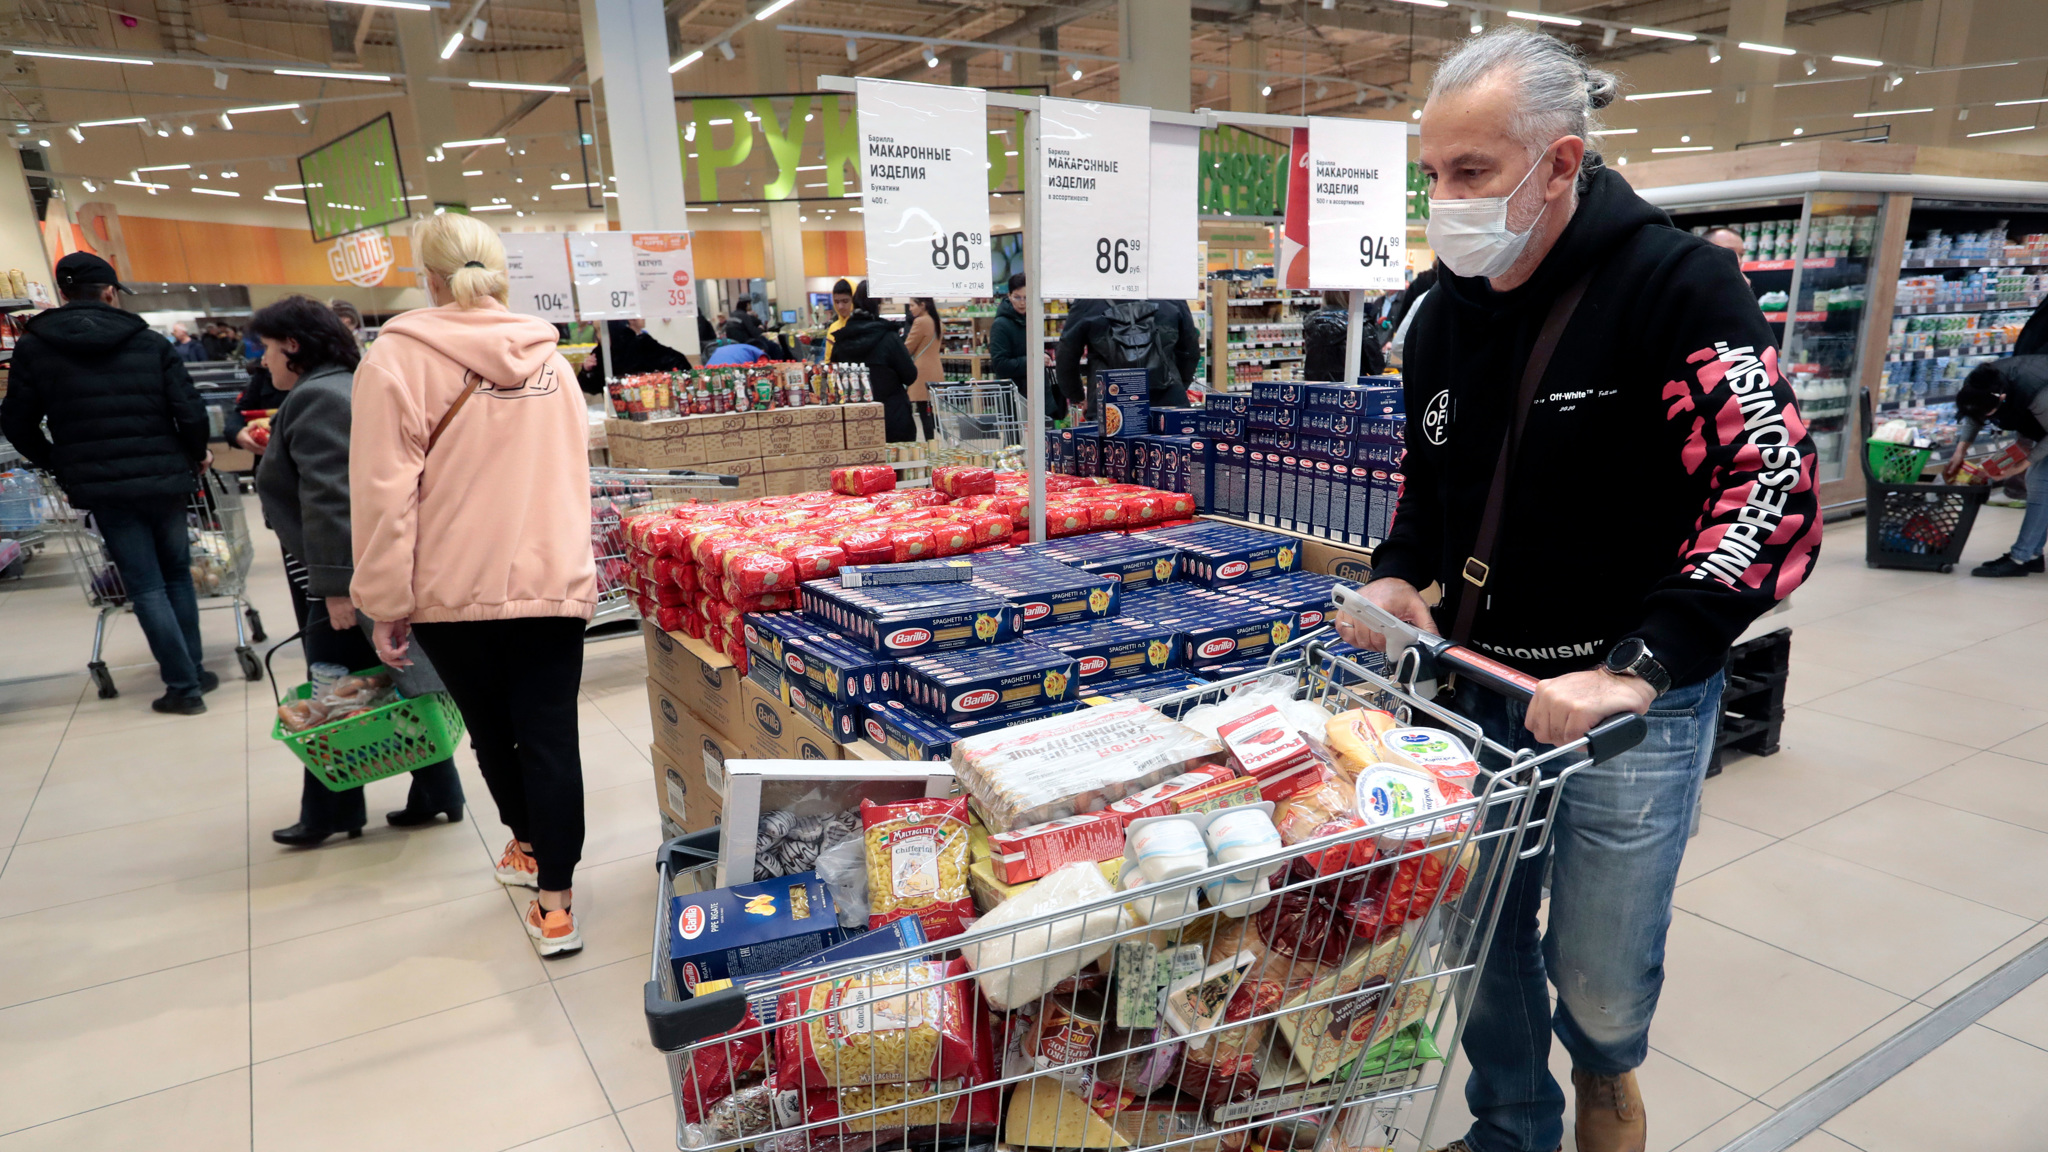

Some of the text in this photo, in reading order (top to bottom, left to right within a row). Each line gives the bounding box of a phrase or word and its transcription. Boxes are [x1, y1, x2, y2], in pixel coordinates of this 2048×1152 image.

[868, 134, 894, 143] Барилла
[869, 143, 951, 161] МАКАРОННЫЕ
[1048, 147, 1070, 156] Барилла
[870, 164, 926, 180] ИЗДЕЛИЯ
[1048, 157, 1119, 173] МАКАРОННЫЕ
[1316, 167, 1379, 180] МАКАРОННЫЕ
[871, 183, 900, 192] Букатини
[1048, 175, 1096, 190] ИЗДЕЛИЯ
[1316, 183, 1359, 195] ИЗДЕЛИЯ
[931, 231, 982, 270] 86 99
[1095, 237, 1141, 274] 86 99
[1360, 235, 1400, 268] 94 99
[577, 260, 603, 268] КЕТЧУП
[972, 260, 985, 270] руб.
[534, 293, 563, 311] 104
[610, 291, 628, 308] 87
[668, 289, 687, 306] 39
[1223, 563, 1246, 575] Barilla
[1051, 591, 1079, 600] SPAGHETTI
[932, 616, 963, 626] SPAGHETTI
[1236, 624, 1261, 634] SPAGHETTI
[895, 632, 927, 644] Barilla
[1108, 643, 1137, 653] SPAGHETTI
[1206, 639, 1233, 653] Barilla
[789, 656, 804, 672] Barilla
[1000, 674, 1032, 686] SPAGHETTI
[963, 693, 995, 708] Barilla
[758, 710, 780, 732] Barilla
[868, 722, 885, 739] Barilla
[685, 905, 697, 931] Barilla
[710, 902, 719, 920] RIGATE
[686, 964, 697, 990] Barilla
[1335, 992, 1381, 1023] СЛИВОНАЯ
